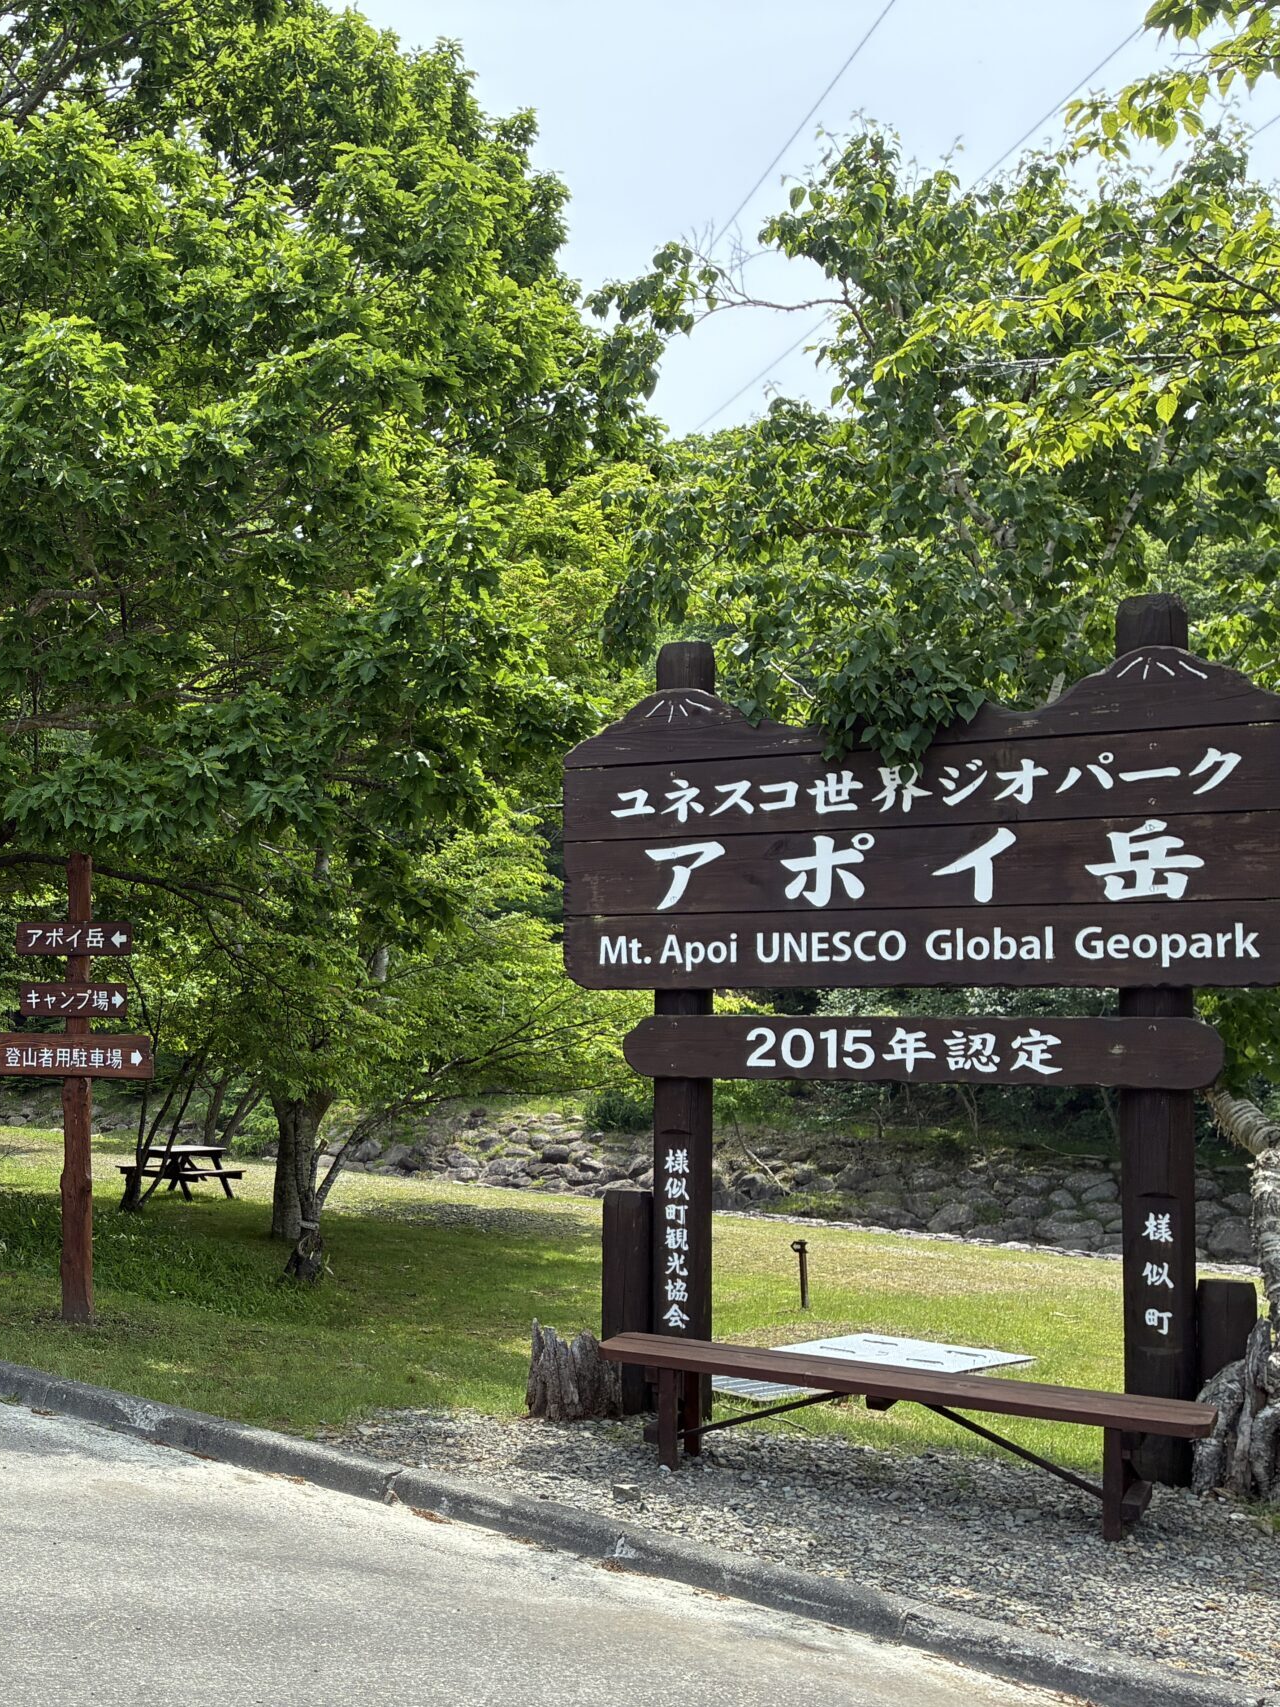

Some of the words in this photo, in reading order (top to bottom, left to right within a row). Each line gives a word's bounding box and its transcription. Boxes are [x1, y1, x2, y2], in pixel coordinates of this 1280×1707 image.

[609, 747, 1242, 823] ユネスコ世界ジオパーク
[644, 819, 1205, 910] アポイ岳
[26, 927, 105, 949] アポイ岳
[599, 935, 652, 965] Mt.
[659, 932, 738, 972] Apoi
[756, 930, 907, 964] UNESCO
[925, 926, 1054, 961] Global
[1074, 922, 1261, 968] Geopark
[26, 989, 110, 1012] キャンプ場
[5, 1047, 123, 1070] 登山者用駐車場
[745, 1026, 1064, 1077] 2015年認定
[662, 1148, 691, 1330] 様似町観光協会
[1141, 1212, 1175, 1336] 様似町
